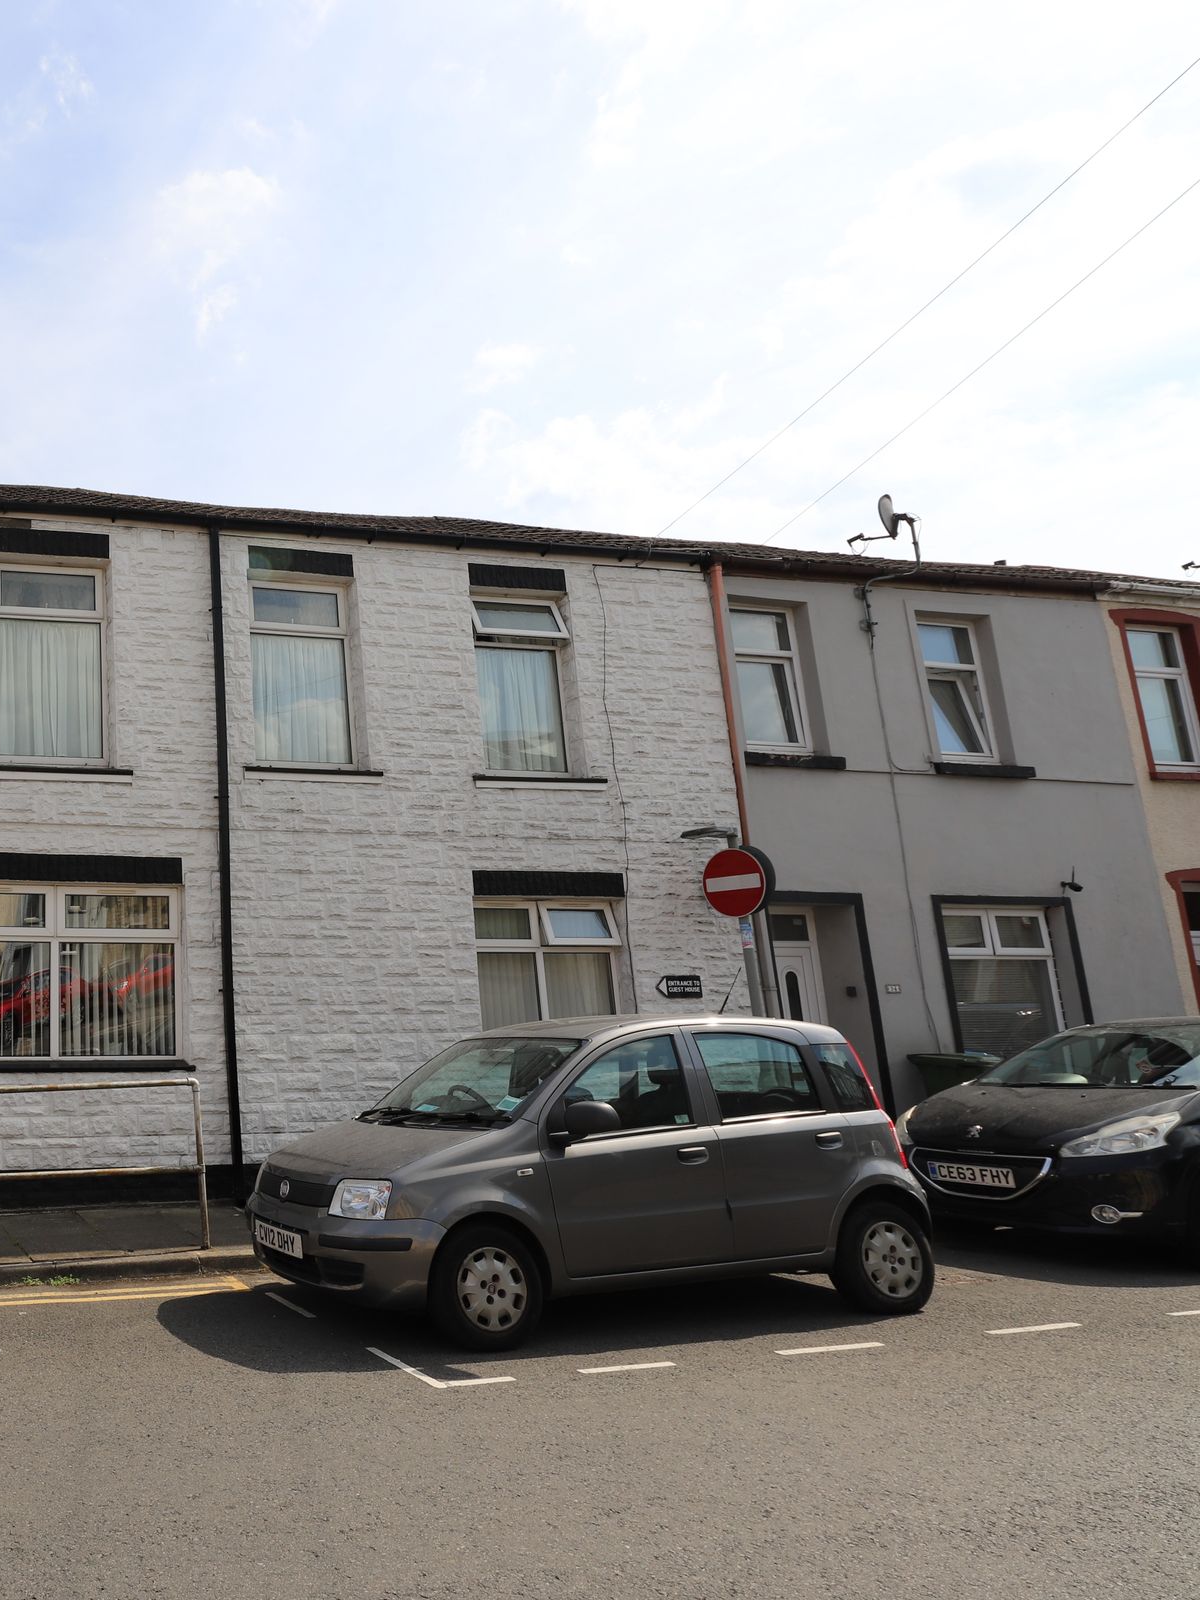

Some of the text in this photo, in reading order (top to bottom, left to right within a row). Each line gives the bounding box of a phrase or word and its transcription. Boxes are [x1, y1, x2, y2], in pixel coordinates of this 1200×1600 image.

[937, 1164, 1010, 1185] CE63 FHY
[258, 1224, 295, 1253] CV12 DHY
